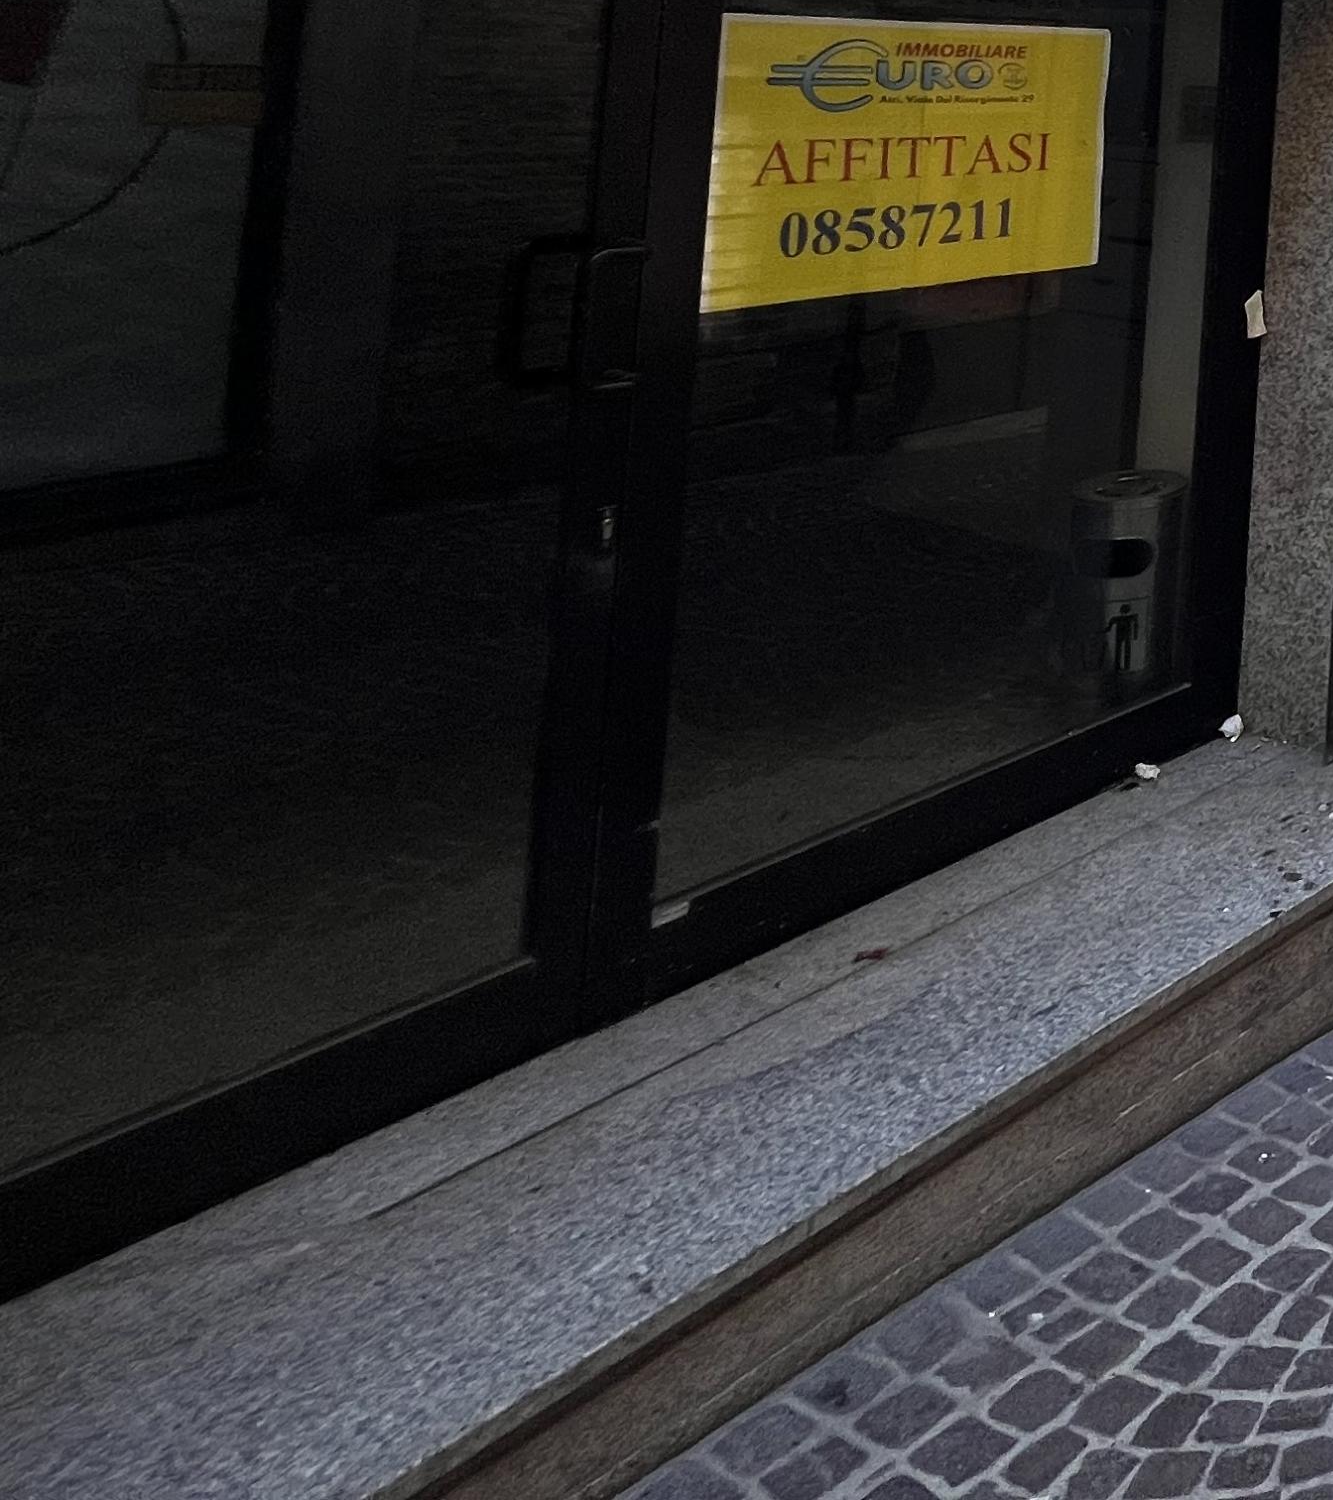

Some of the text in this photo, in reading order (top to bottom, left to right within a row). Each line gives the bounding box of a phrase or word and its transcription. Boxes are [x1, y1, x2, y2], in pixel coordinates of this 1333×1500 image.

[895, 41, 1028, 60] IMMOBILIARE
[751, 133, 1051, 187] AFFITTASI
[779, 197, 1013, 259] 08587211
